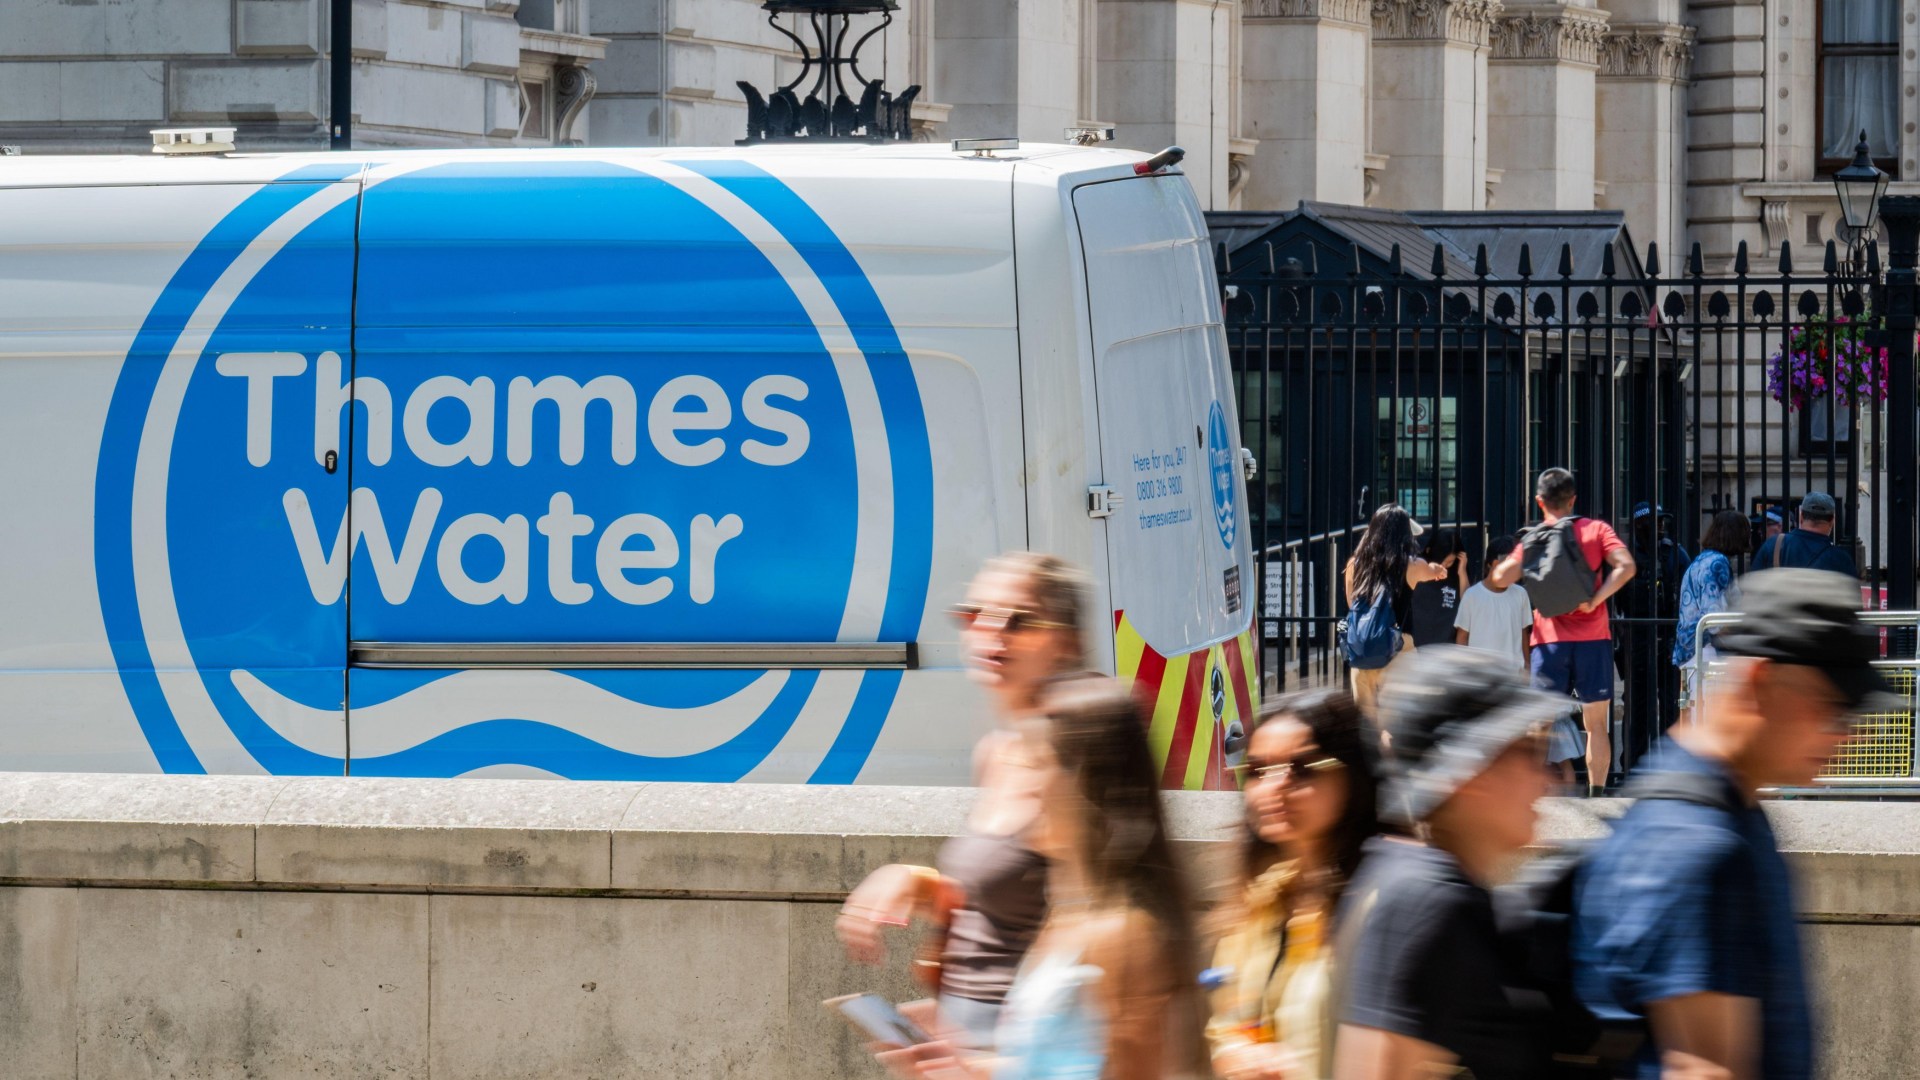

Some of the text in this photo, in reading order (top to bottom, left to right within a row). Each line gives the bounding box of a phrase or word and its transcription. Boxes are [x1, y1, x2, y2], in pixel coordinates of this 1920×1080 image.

[215, 351, 811, 467] Thames
[1133, 453, 1150, 472] Here
[1151, 449, 1160, 469] for
[1137, 475, 1182, 501] 0800 316 9800
[1139, 501, 1192, 530] thameswater.co.uk
[282, 487, 744, 605] Water
